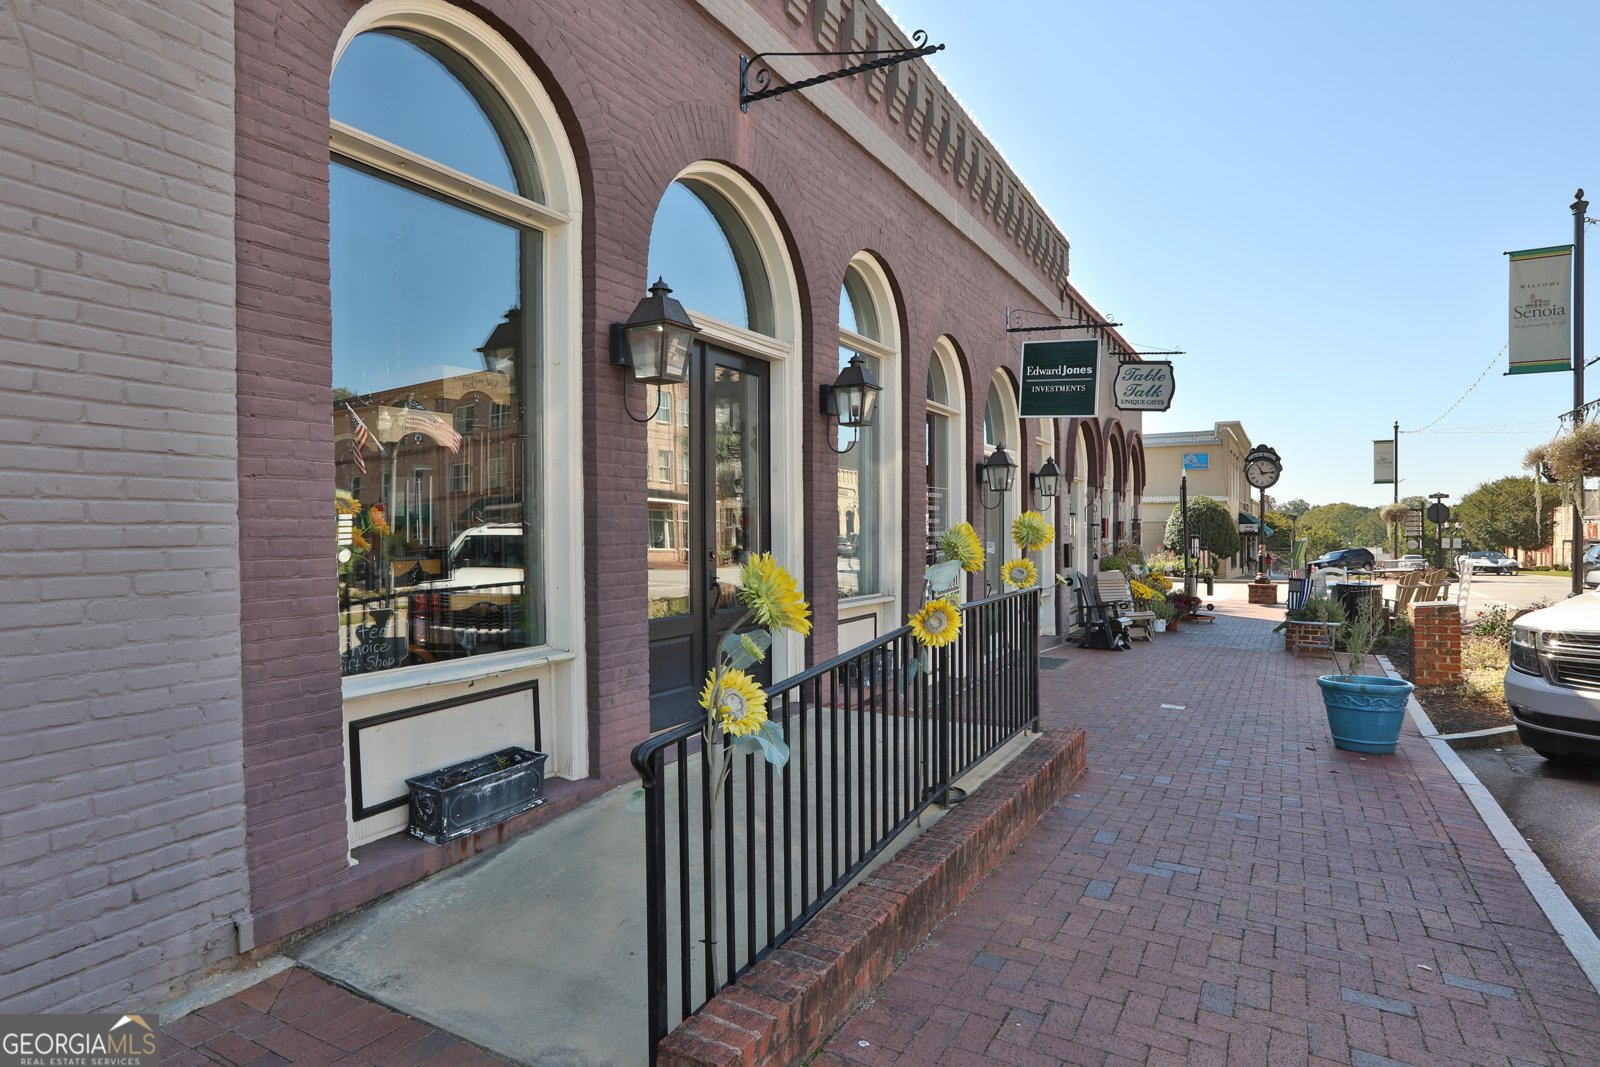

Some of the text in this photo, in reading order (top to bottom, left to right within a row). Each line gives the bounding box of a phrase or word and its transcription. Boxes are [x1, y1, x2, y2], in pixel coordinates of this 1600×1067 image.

[1520, 281, 1560, 289] WELCOME
[1513, 304, 1566, 319] Senoia
[1122, 367, 1167, 381] Table
[1031, 384, 1086, 393] INVESTMENTS
[1123, 383, 1163, 397] Talk
[364, 654, 395, 671] Shop
